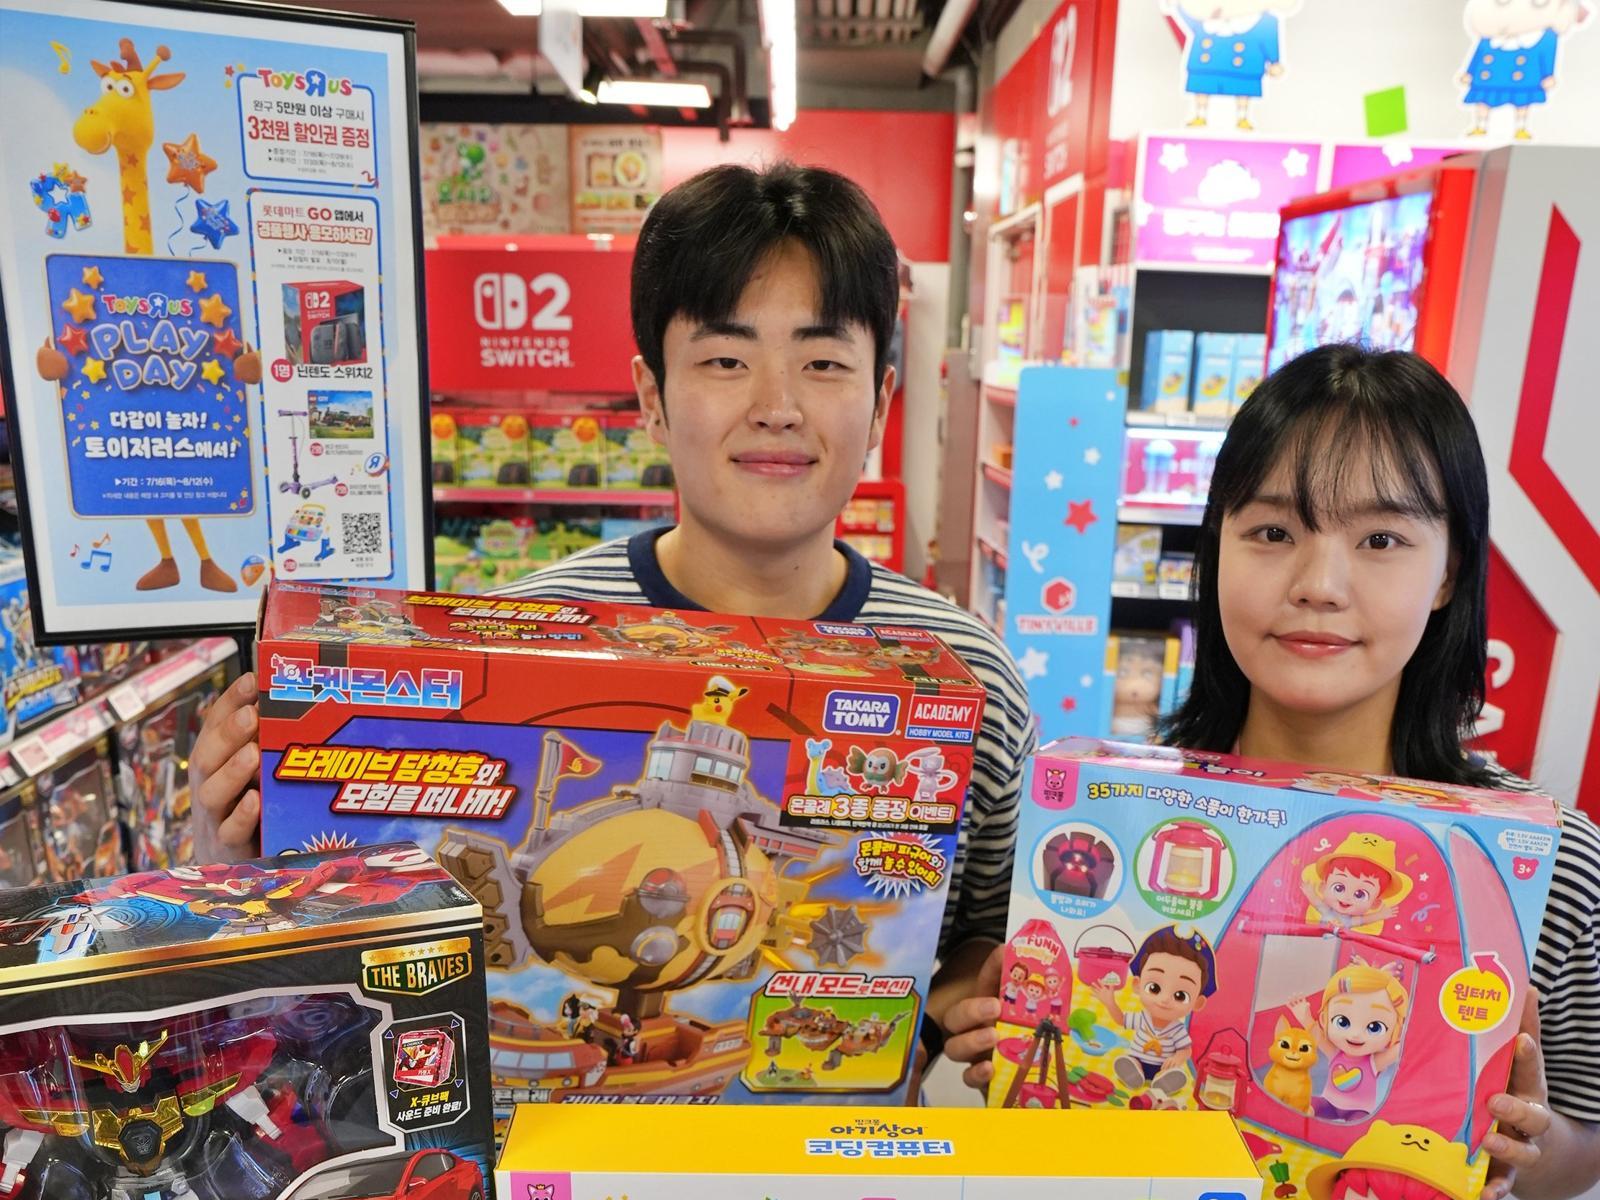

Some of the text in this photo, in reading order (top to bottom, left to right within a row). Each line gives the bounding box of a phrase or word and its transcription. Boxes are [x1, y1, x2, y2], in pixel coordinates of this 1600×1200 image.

[253, 99, 365, 121] 완구 5만원 이상 구매시
[248, 115, 370, 149] 3천원 할인권 증정
[307, 207, 332, 221] GO
[334, 209, 364, 223] 앱에서
[90, 320, 209, 361] PLAY
[480, 336, 569, 348] NINTENDO
[480, 350, 570, 368] SWITCH
[112, 354, 197, 391] DAY
[297, 364, 331, 379] 닌텐도
[334, 367, 373, 381] 스위치2
[110, 411, 207, 430] 다같이 놀자!
[85, 436, 236, 460] 토이저러스에서!
[1017, 617, 1097, 633] TINYVILLE
[270, 655, 463, 710] 포켓몬스터
[834, 697, 892, 714] TAKARA
[914, 702, 972, 723] ACADEMY
[832, 711, 890, 728] TOMY
[909, 728, 970, 741] HOBBY MODEL KITS
[279, 748, 396, 780] 브레이브
[1088, 783, 1287, 828] 35가지 다양한 소품이 한가득!
[1517, 863, 1532, 874] 3+
[371, 957, 465, 988] THE BRAVES
[1453, 983, 1501, 1002] 원터치
[1458, 1005, 1488, 1020] 텐트
[410, 1091, 449, 1107] X-큐브팩
[396, 1108, 422, 1122] 사운드
[423, 1104, 440, 1117] 준비
[830, 1122, 924, 1138] 아기상어
[807, 1139, 954, 1157] 코딩컴퓨터
